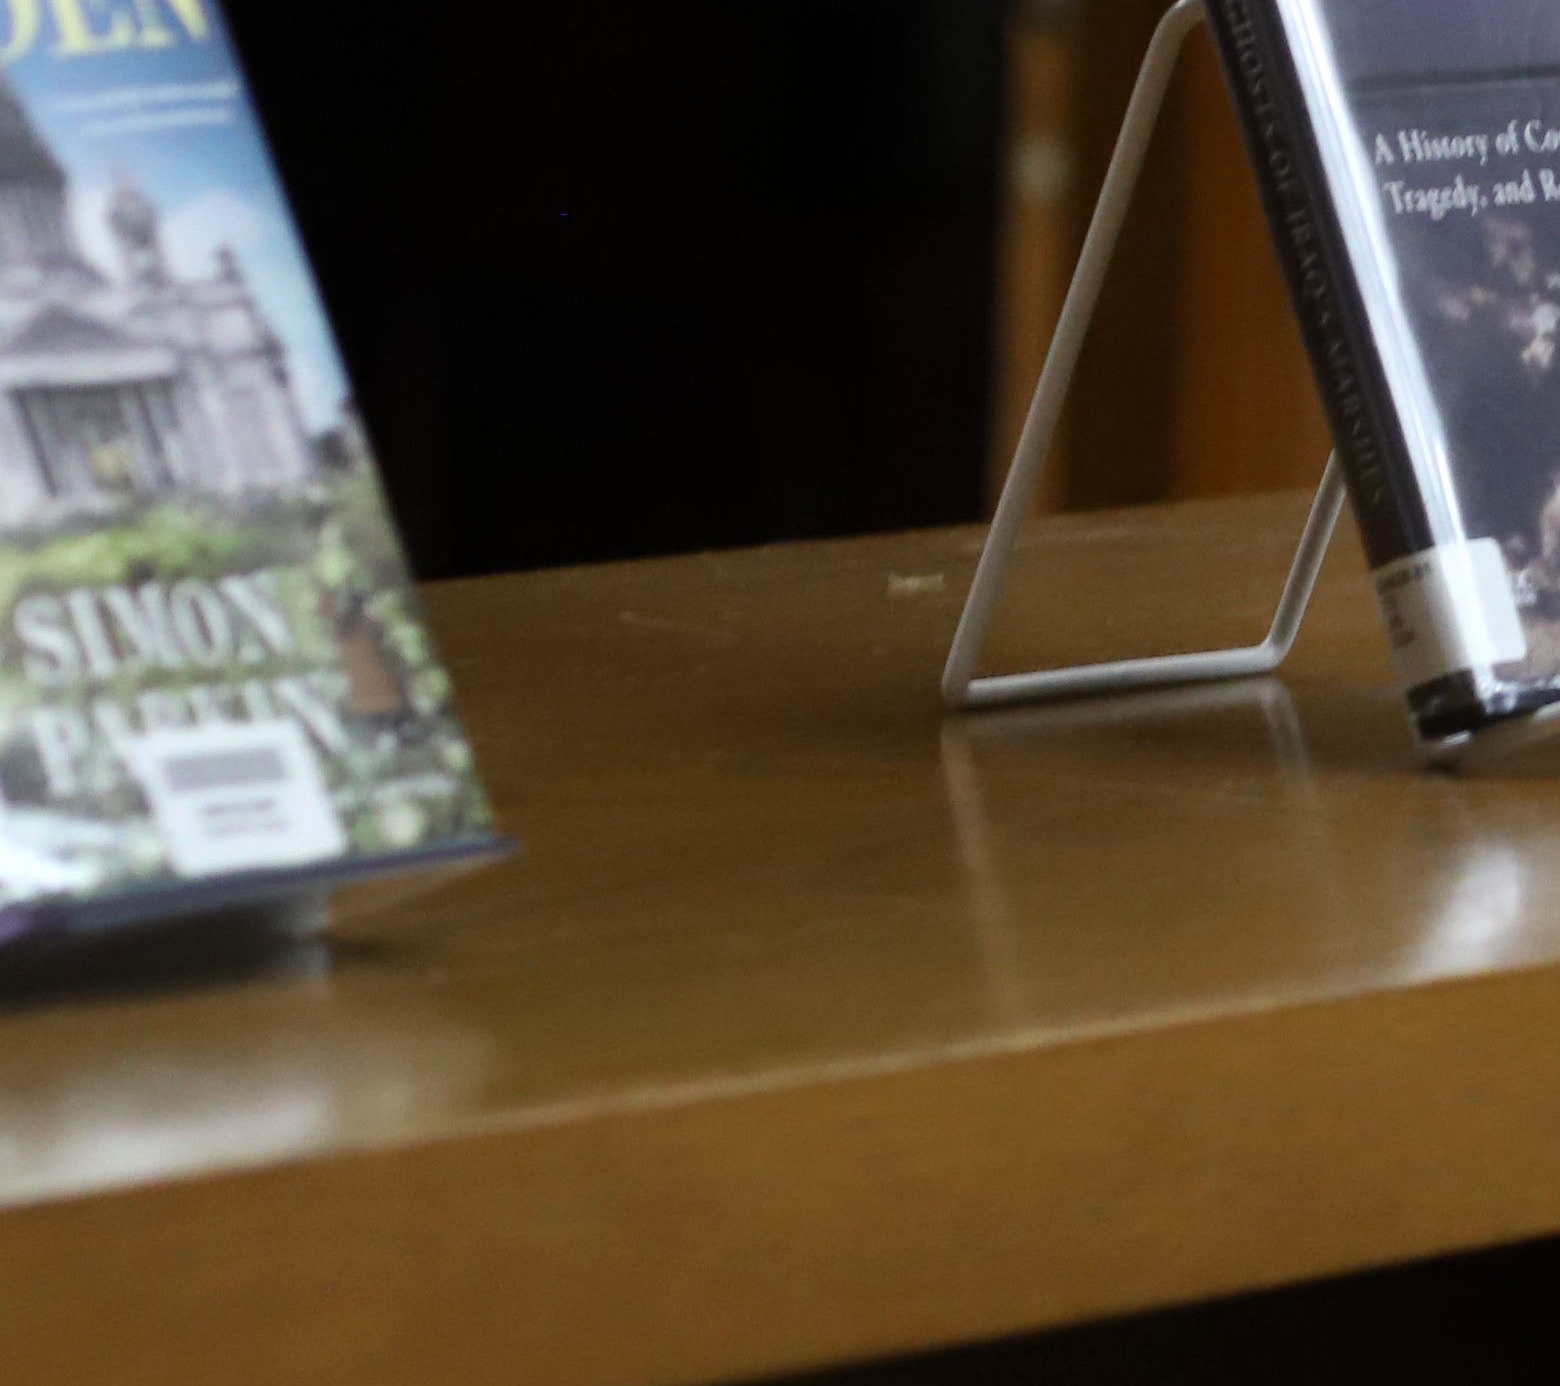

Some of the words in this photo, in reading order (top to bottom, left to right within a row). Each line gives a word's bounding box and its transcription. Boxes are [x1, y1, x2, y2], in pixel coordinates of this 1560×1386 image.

[1374, 134, 1394, 163] A
[1398, 125, 1489, 166] History
[1495, 126, 1521, 155] of
[1382, 179, 1488, 220] Tragedy,
[1492, 176, 1534, 204] and
[15, 572, 294, 686] SIMON
